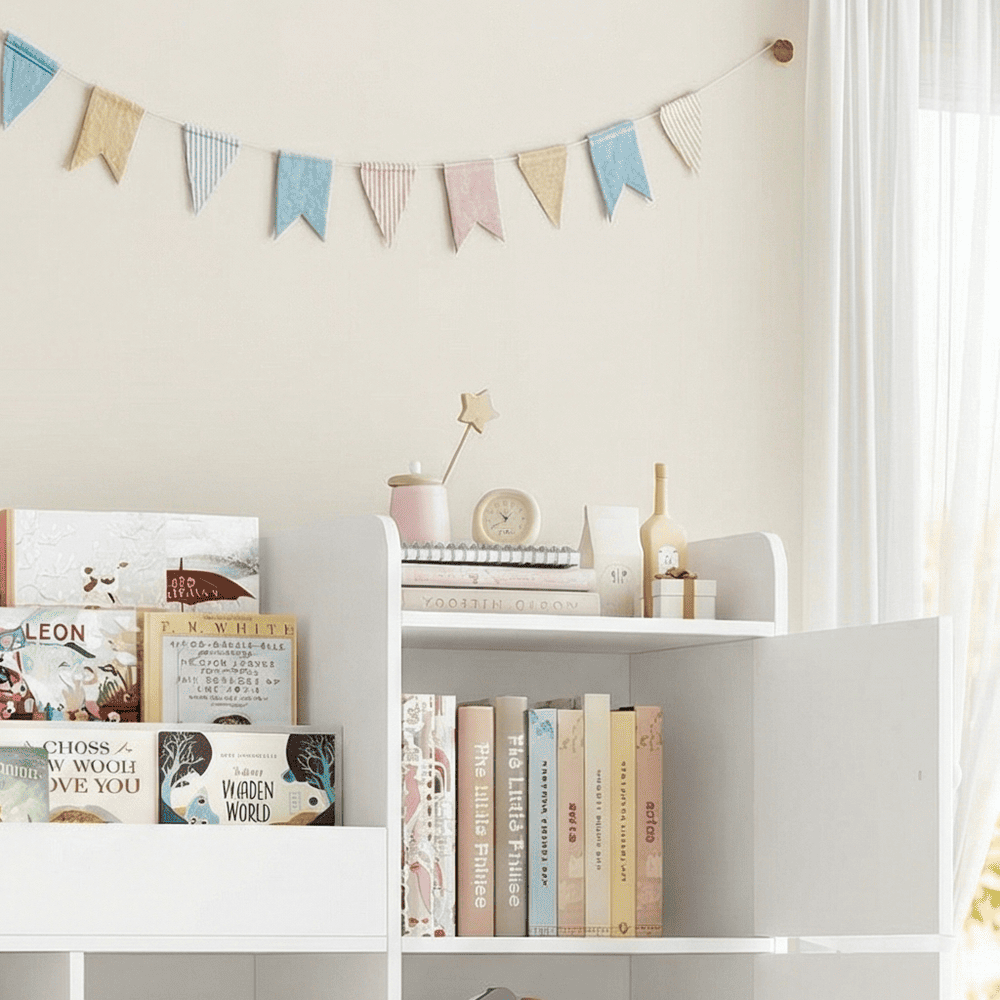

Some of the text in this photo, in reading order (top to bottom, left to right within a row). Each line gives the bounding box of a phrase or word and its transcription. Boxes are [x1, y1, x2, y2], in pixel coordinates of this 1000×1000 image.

[25, 623, 85, 641] LEON
[94, 777, 141, 793] YOU
[226, 801, 271, 823] WORLD
